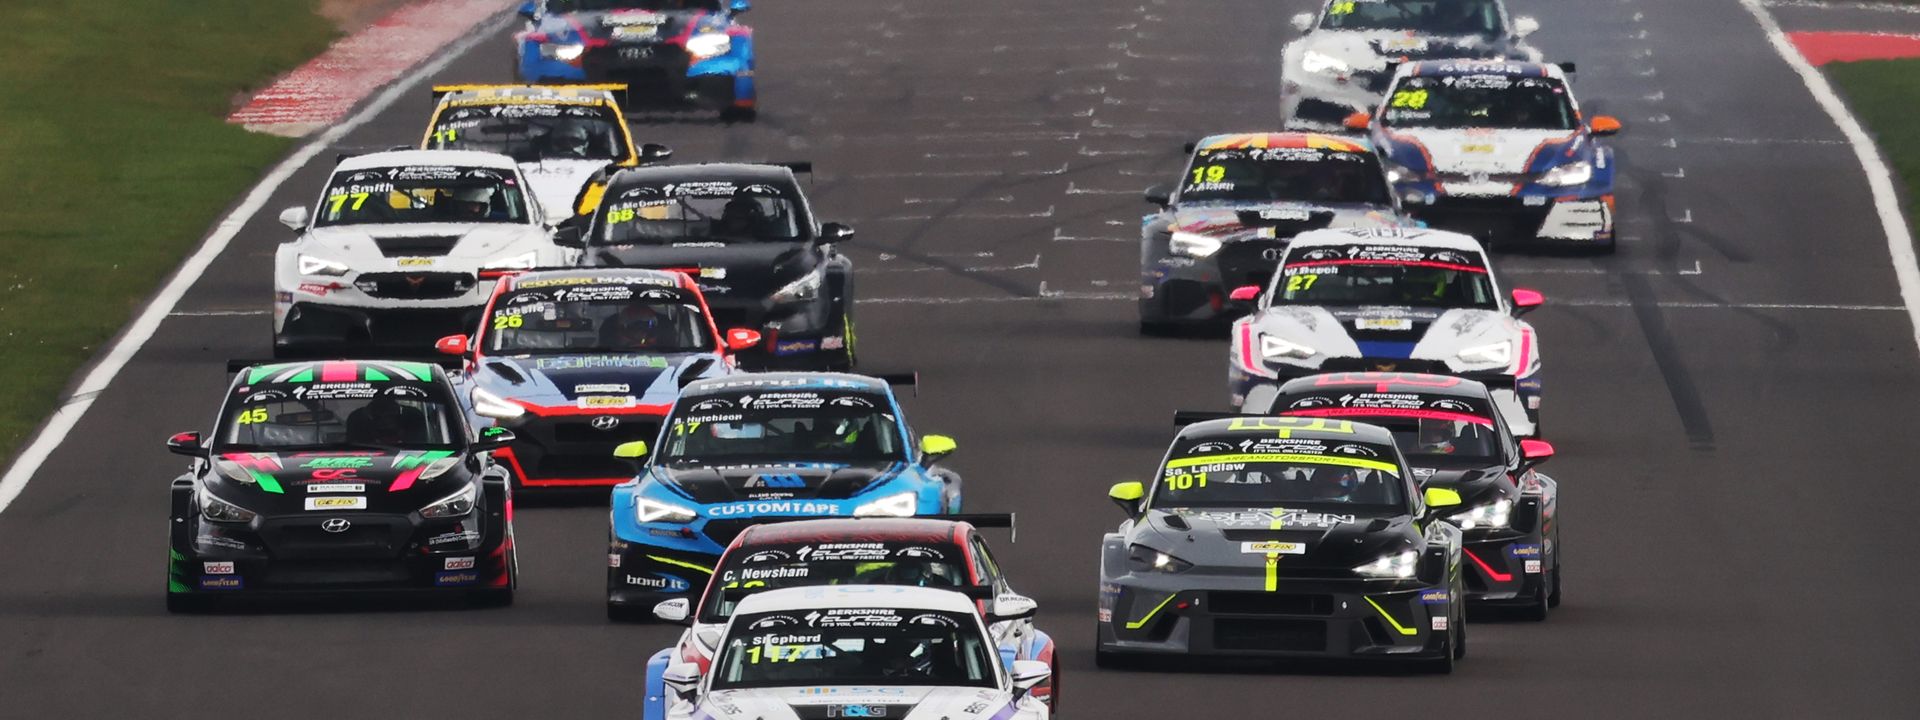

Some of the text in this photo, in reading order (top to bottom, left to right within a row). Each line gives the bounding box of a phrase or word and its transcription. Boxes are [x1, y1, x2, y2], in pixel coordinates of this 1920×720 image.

[1193, 165, 1225, 184] 19
[330, 192, 369, 213] 77
[1287, 274, 1318, 292] 27
[494, 314, 523, 330] 26
[236, 408, 268, 425] 45
[687, 413, 743, 424] Hutchison
[674, 422, 701, 437] 17
[1165, 463, 1246, 477] Sa. Laidlaw
[1164, 472, 1207, 491] 101
[708, 501, 840, 517] CUSTOMTAPE
[627, 574, 686, 590] bond it
[723, 567, 809, 582] C. Newsham
[820, 614, 903, 623] turbo
[732, 634, 821, 647] A. Shepherd
[746, 644, 806, 664] 117
